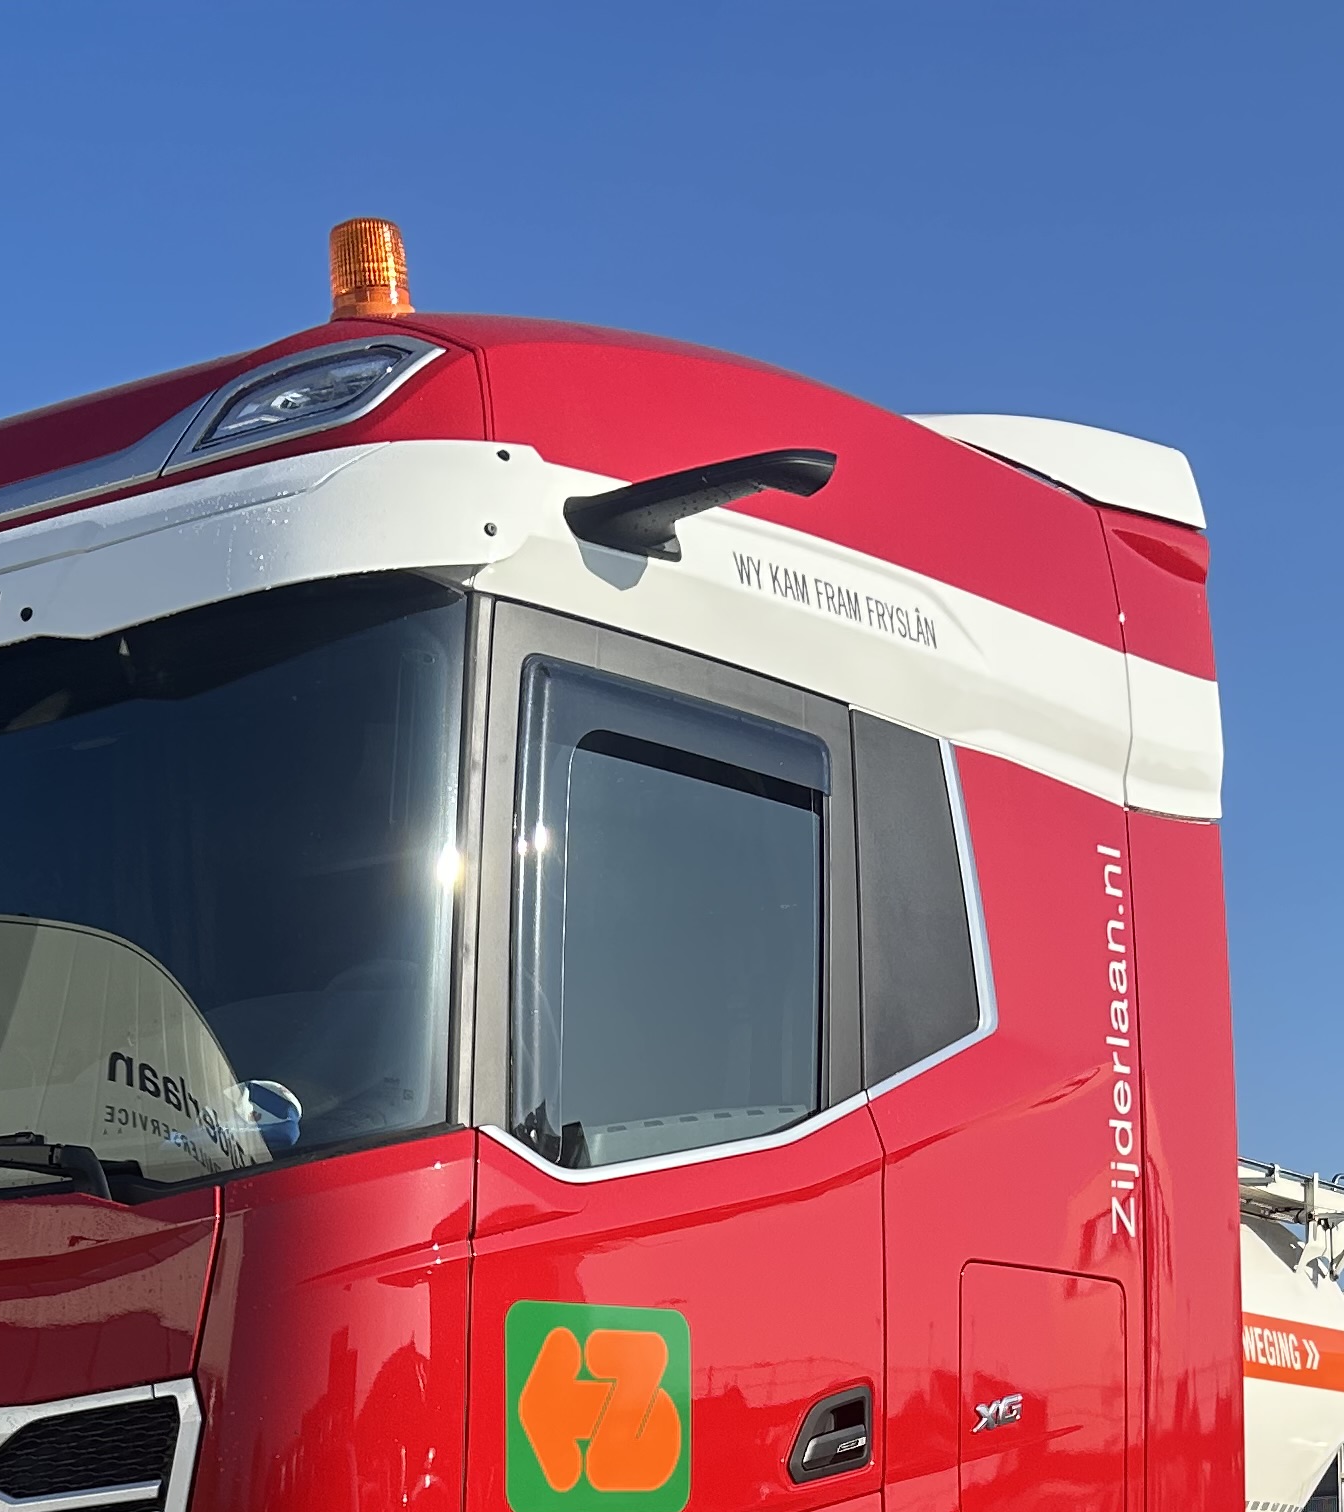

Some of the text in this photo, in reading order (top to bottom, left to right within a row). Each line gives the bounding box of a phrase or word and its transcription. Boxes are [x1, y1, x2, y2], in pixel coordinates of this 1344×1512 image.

[733, 551, 938, 650] WY KAM FRAM FRYSLÂN
[1096, 844, 1140, 1239] Zijderlaan.nl
[970, 1393, 1024, 1433] XG
